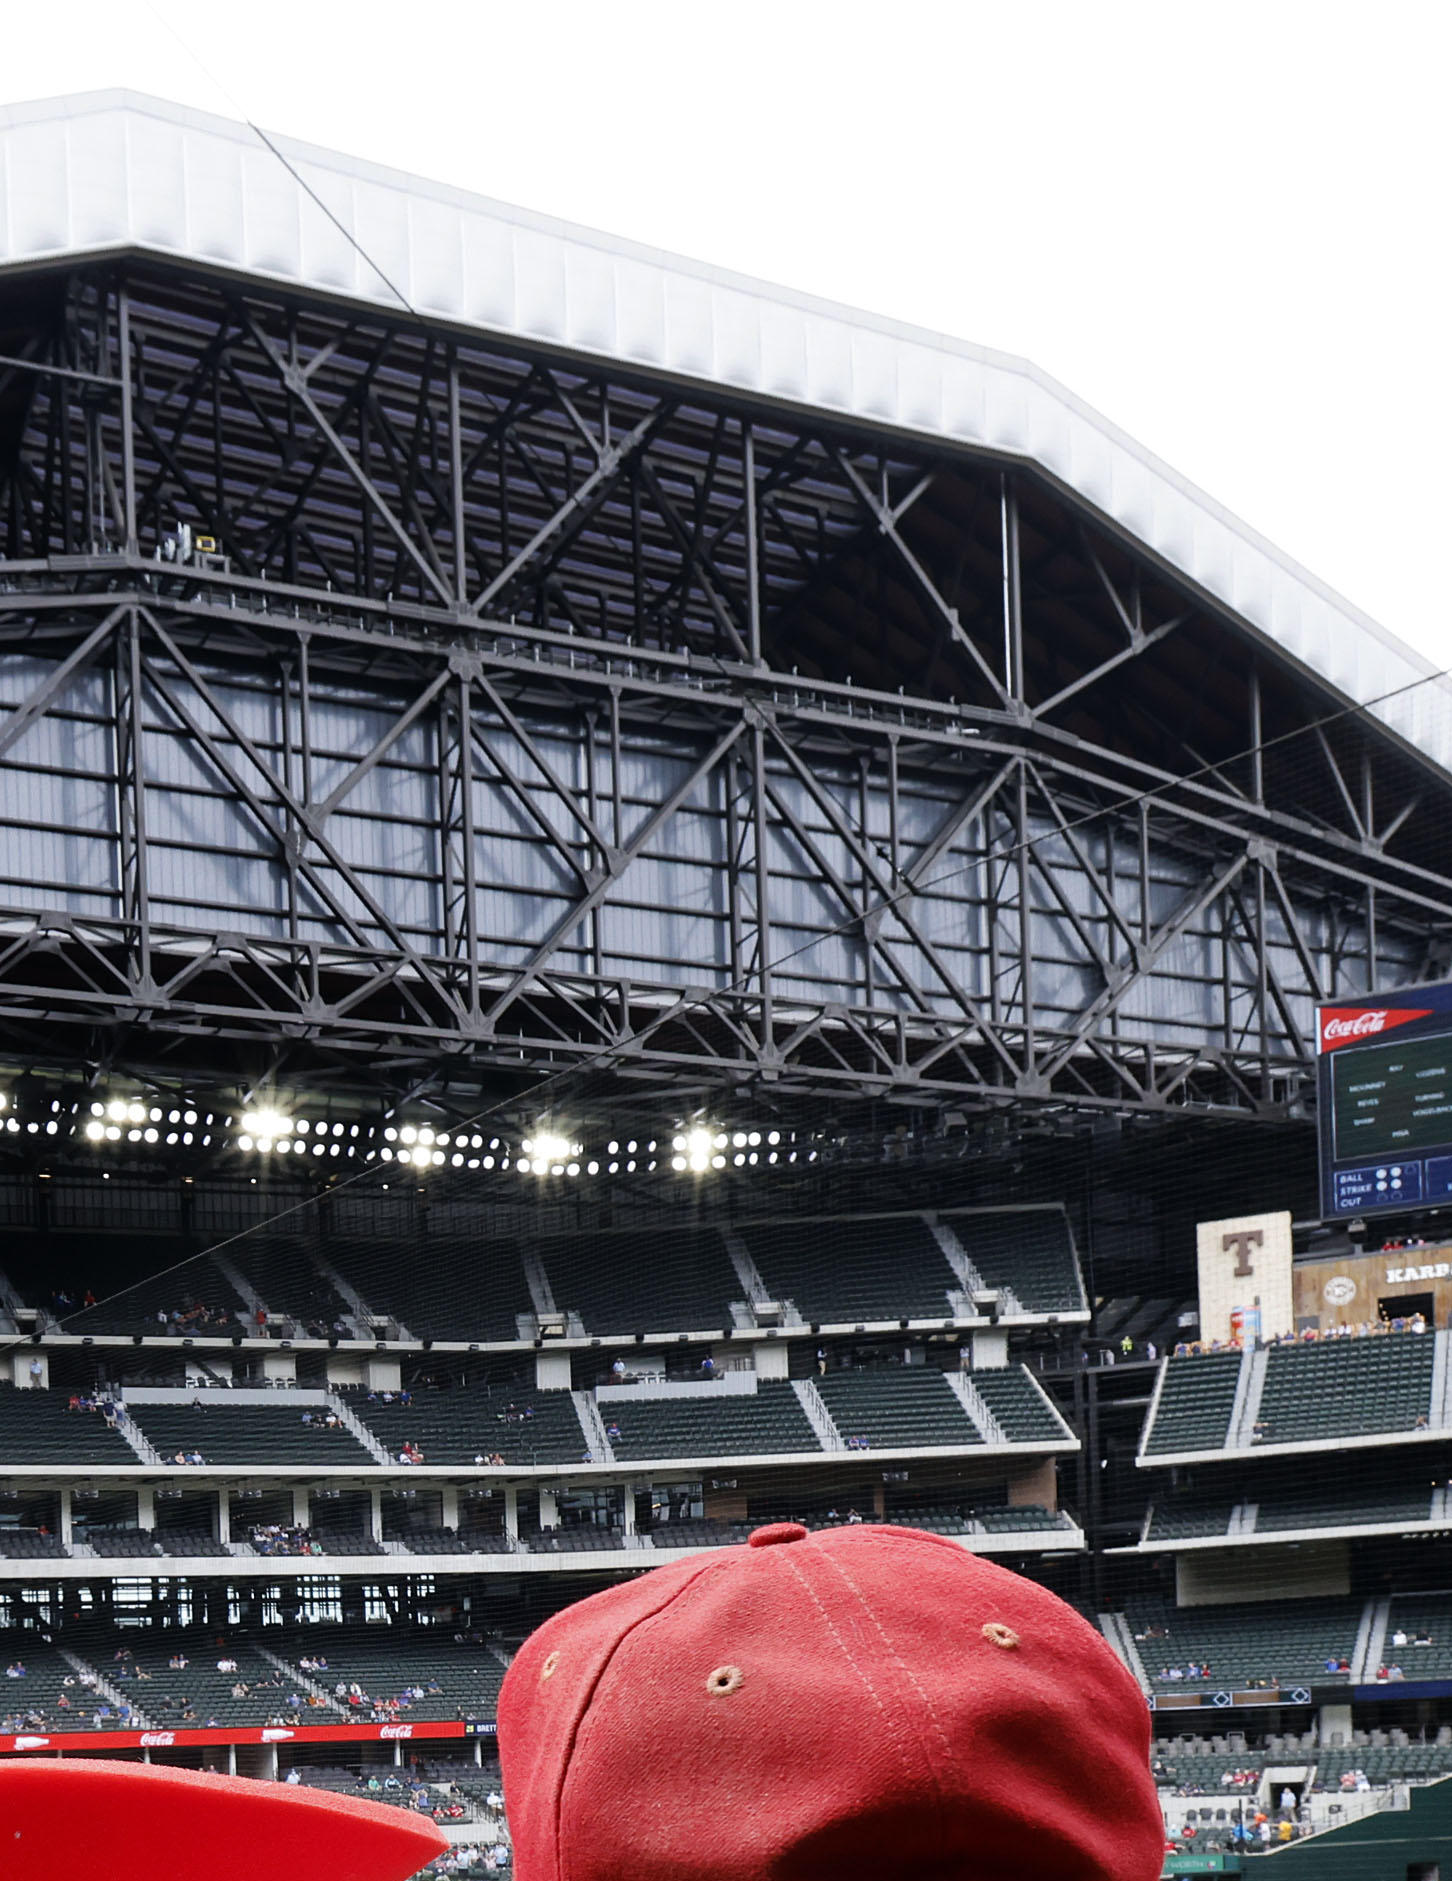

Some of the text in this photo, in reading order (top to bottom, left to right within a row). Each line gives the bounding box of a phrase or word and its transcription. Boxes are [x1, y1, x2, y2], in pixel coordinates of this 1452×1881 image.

[1324, 1011, 1388, 1040] Coca-Cola
[1339, 1174, 1363, 1185] BALL
[1339, 1183, 1372, 1197] STRIKE
[1222, 1229, 1263, 1277] T
